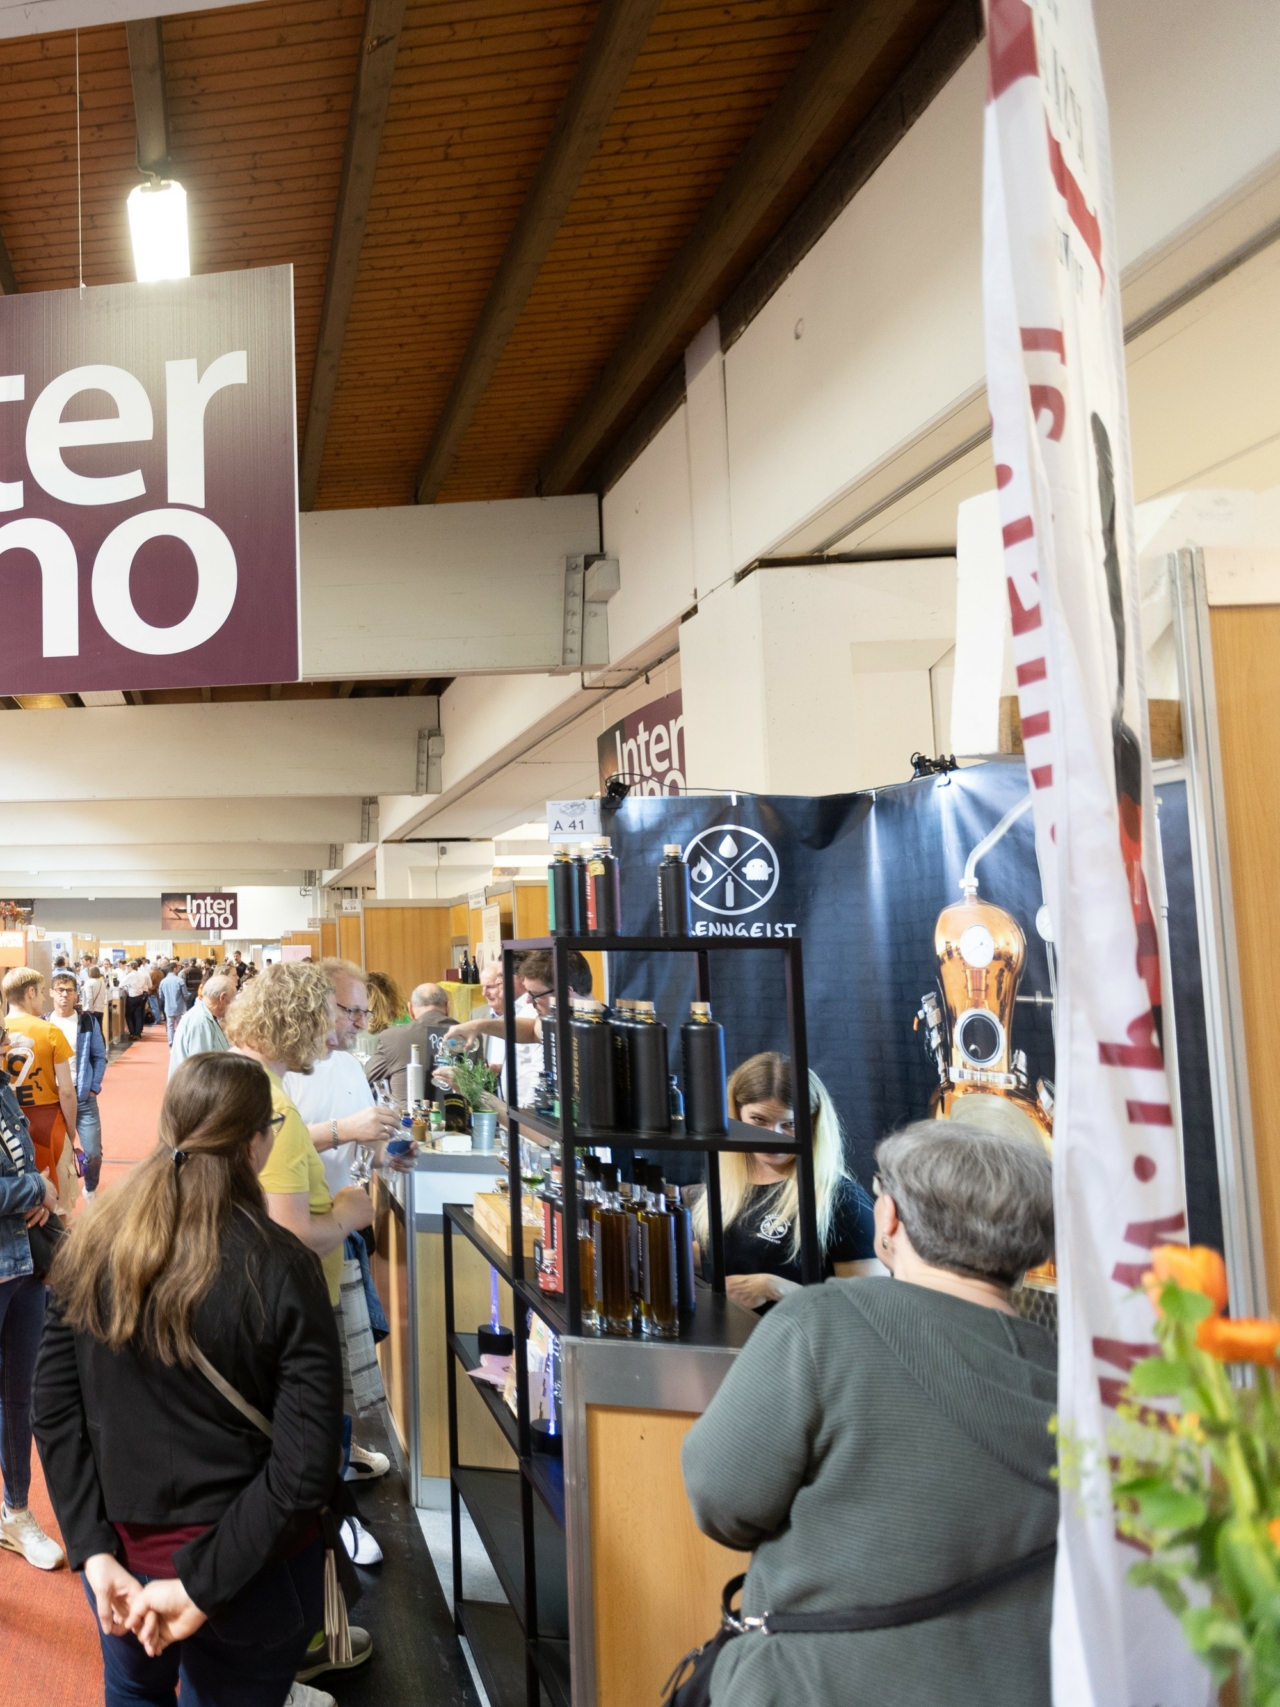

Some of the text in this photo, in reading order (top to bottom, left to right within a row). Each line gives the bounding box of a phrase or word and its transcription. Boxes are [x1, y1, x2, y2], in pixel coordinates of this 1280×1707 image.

[615, 714, 684, 784] Inter
[553, 819, 585, 831] A 41
[186, 894, 235, 916] Inter
[187, 910, 234, 928] vino
